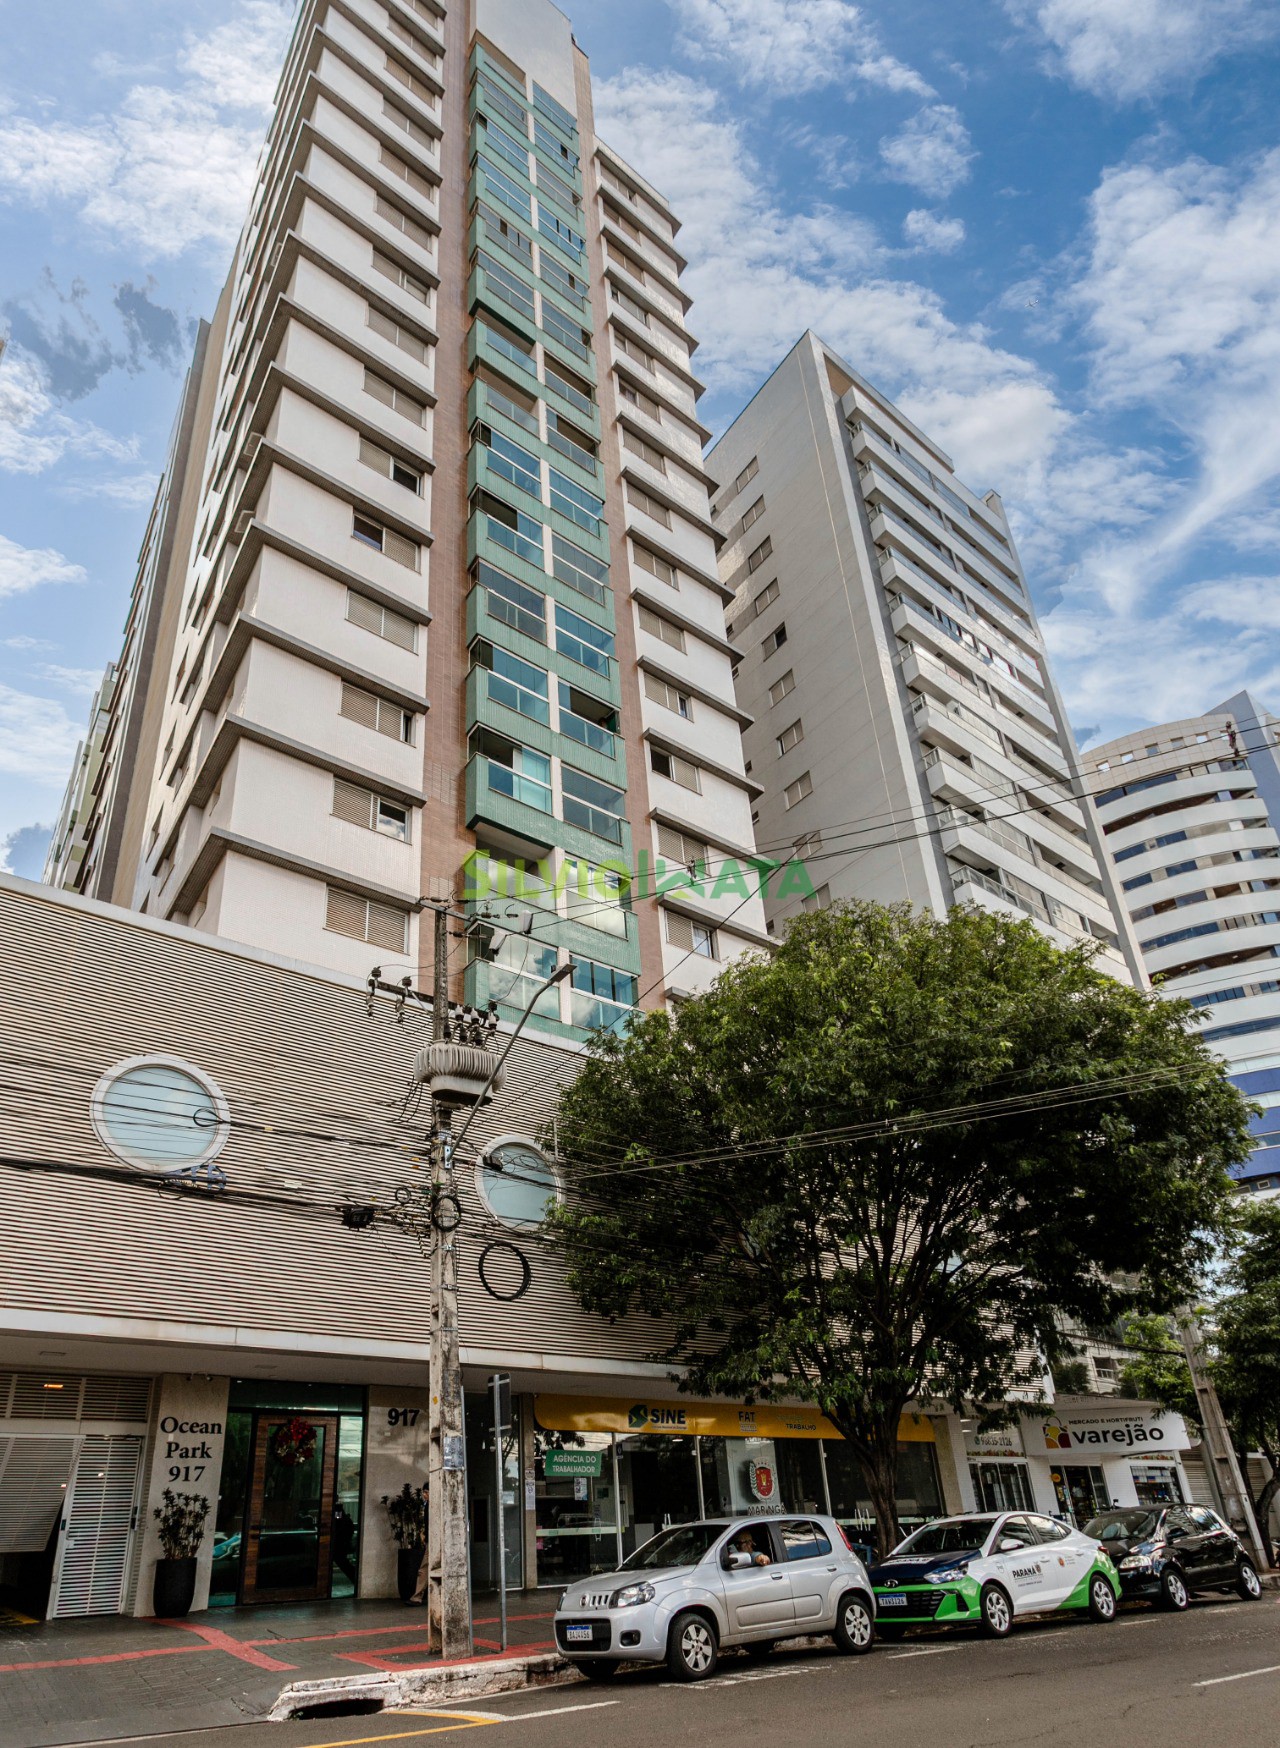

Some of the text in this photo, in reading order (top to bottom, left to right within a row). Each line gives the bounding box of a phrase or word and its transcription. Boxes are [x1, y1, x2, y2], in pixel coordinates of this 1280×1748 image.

[387, 1408, 420, 1427] 917
[738, 1411, 755, 1422] FAT
[160, 1416, 222, 1435] Ocean
[786, 1423, 817, 1431] TRABALHO
[1071, 1423, 1164, 1447] varejão
[165, 1441, 212, 1459] Park
[553, 1453, 597, 1464] AGÊNCIA DO
[168, 1465, 206, 1482] 917
[552, 1465, 596, 1473] TRABALHADOR
